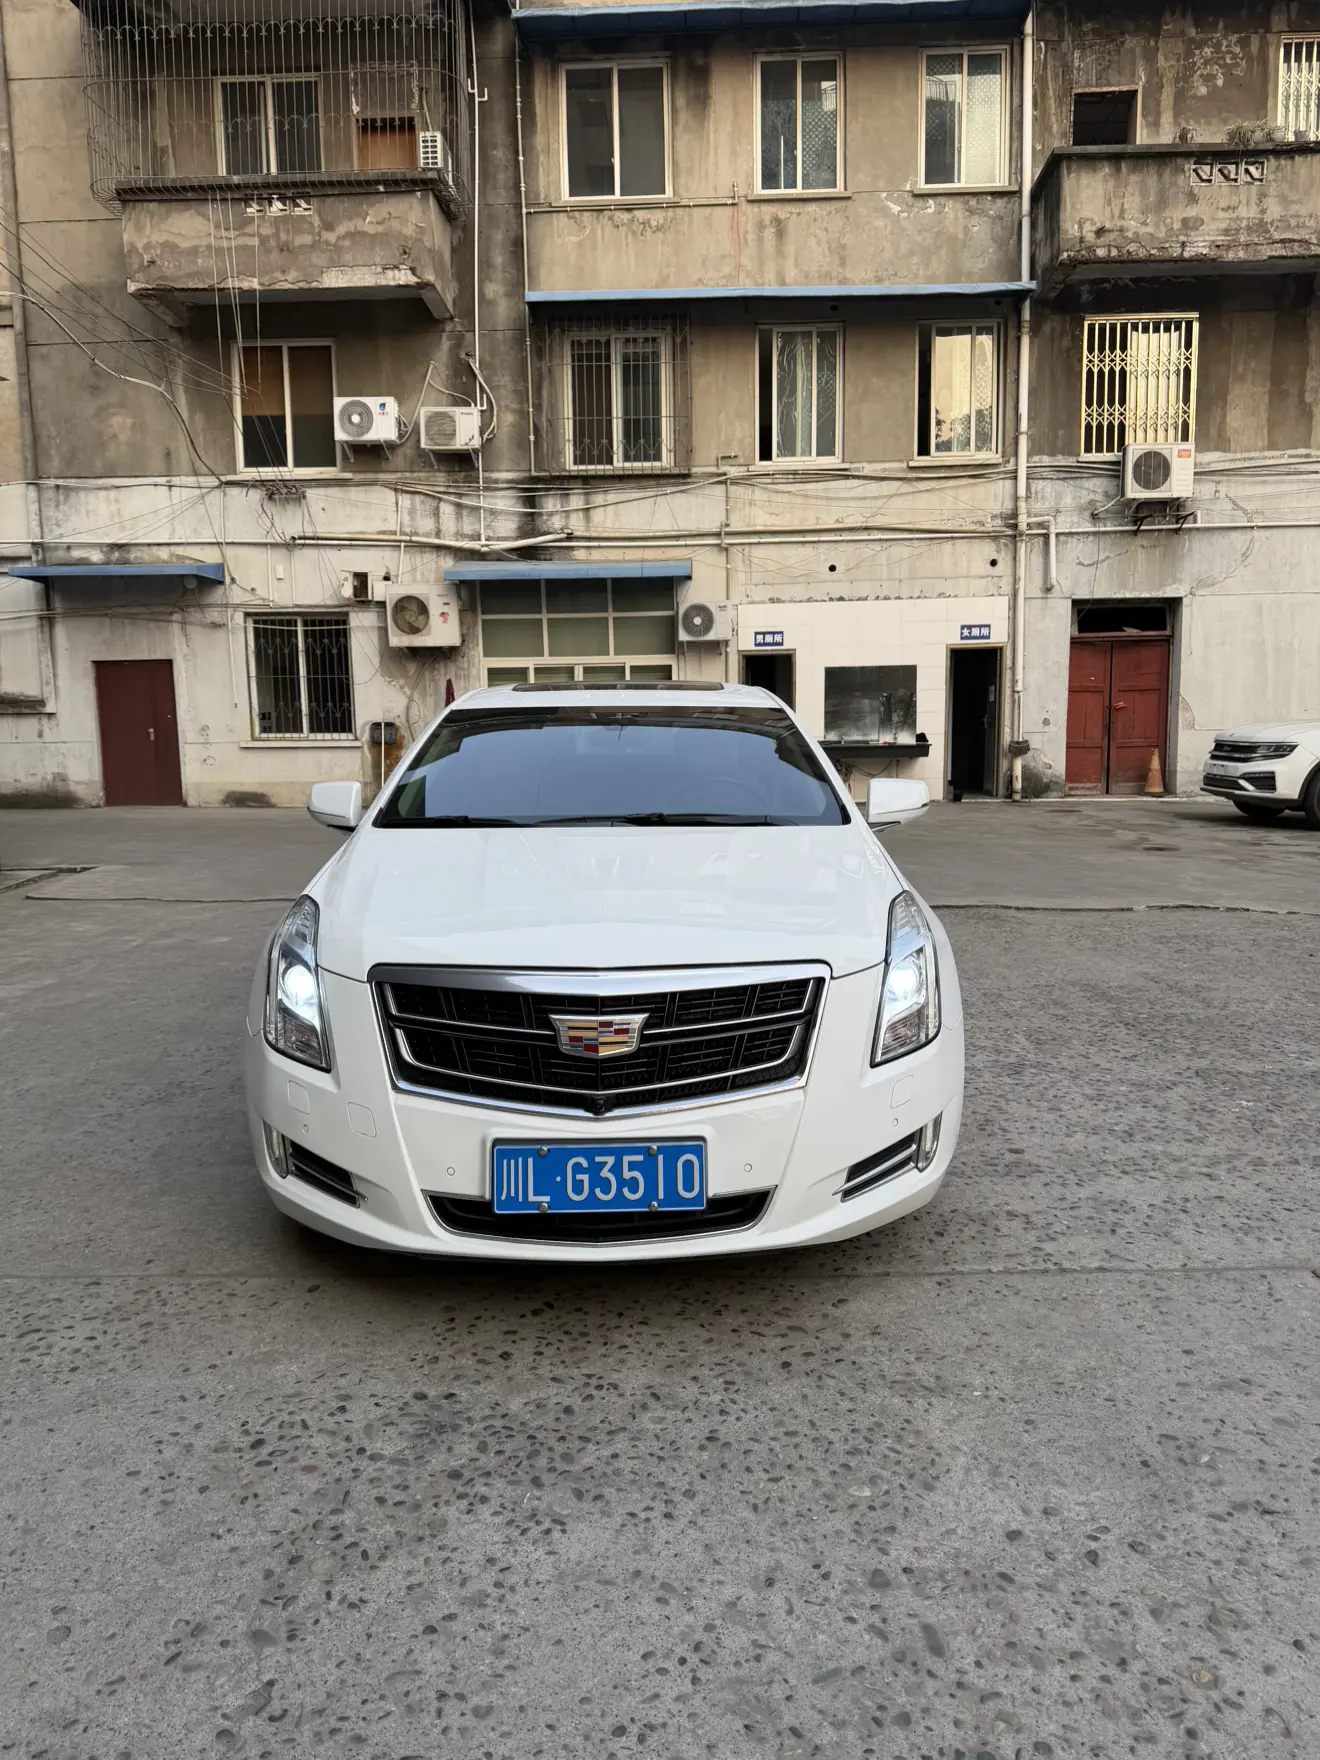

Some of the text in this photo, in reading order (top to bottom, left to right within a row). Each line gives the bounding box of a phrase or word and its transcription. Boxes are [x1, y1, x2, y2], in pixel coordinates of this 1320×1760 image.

[961, 627, 990, 637] 女厕所
[755, 633, 783, 644] 男厕所
